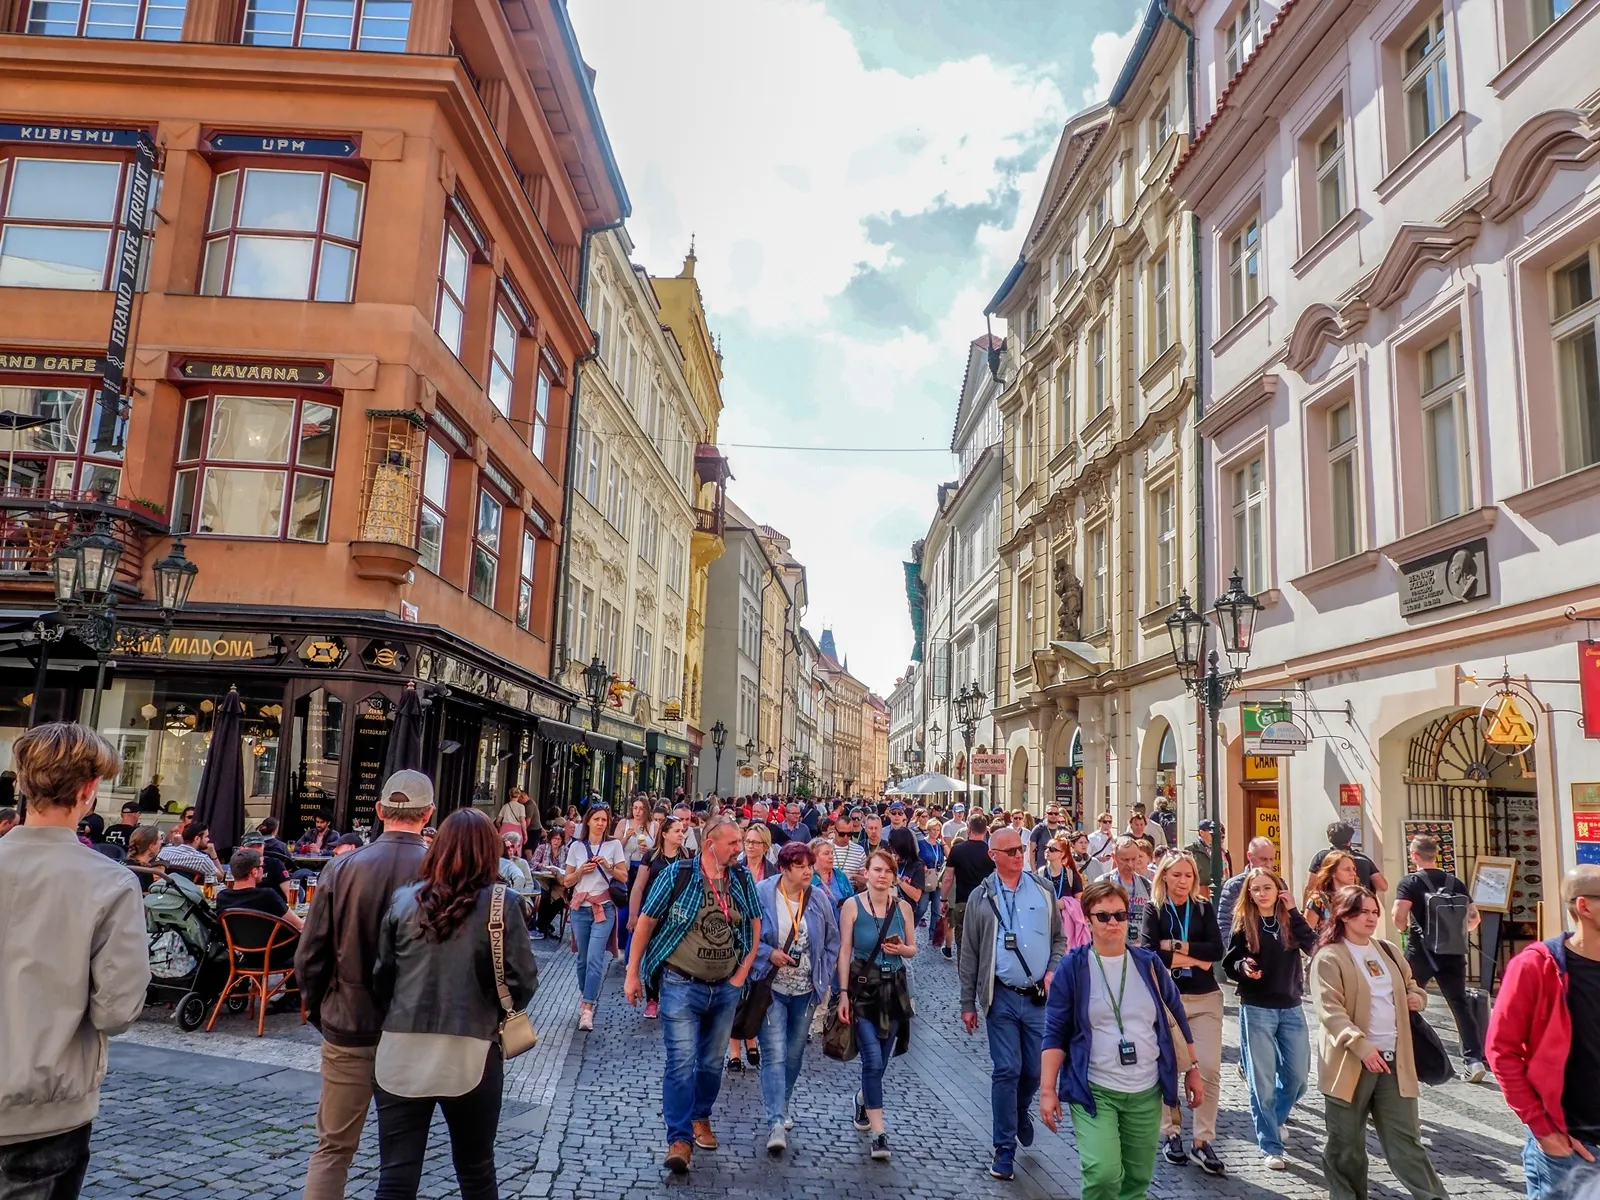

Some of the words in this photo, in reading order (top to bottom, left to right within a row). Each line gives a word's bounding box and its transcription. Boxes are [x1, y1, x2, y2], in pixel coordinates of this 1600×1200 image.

[21, 127, 114, 143] KUBISMU
[262, 139, 305, 151] UPM
[129, 162, 149, 230] ORIENT
[122, 230, 140, 279] CAFE
[111, 282, 132, 348] GRAND
[43, 357, 97, 371] CAFE
[168, 637, 254, 657] MADONA
[491, 930, 505, 987] VALENTINO
